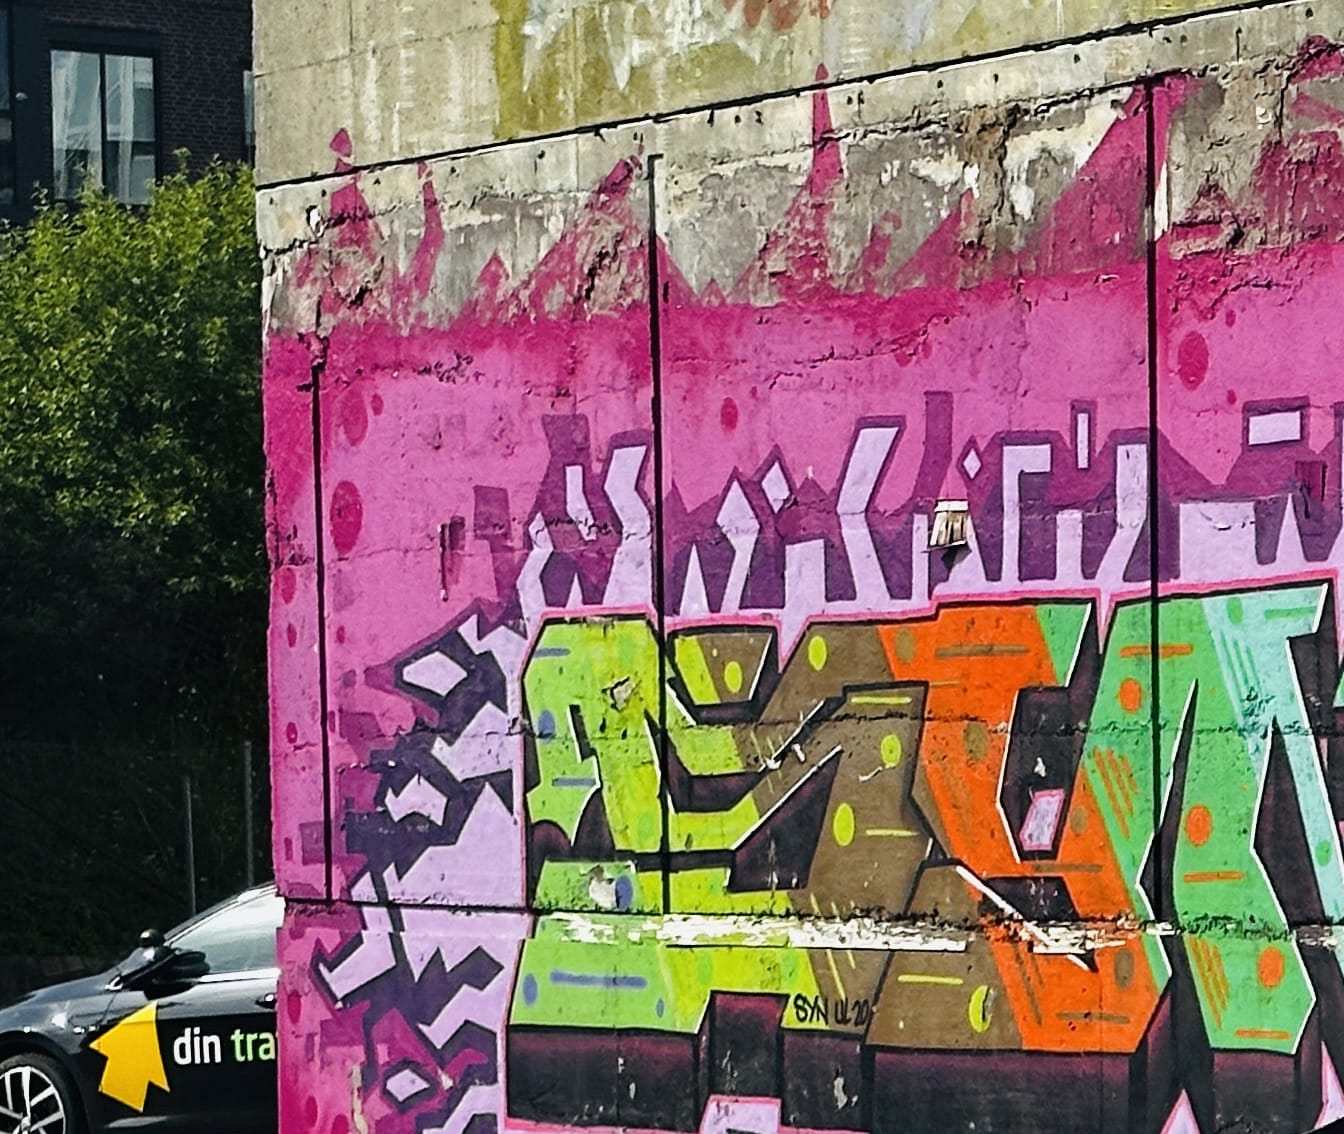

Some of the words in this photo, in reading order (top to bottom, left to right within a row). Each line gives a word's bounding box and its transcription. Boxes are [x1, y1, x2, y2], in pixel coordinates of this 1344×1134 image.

[793, 993, 829, 1026] SYN
[173, 1026, 222, 1065] din
[230, 1028, 277, 1062] tra
